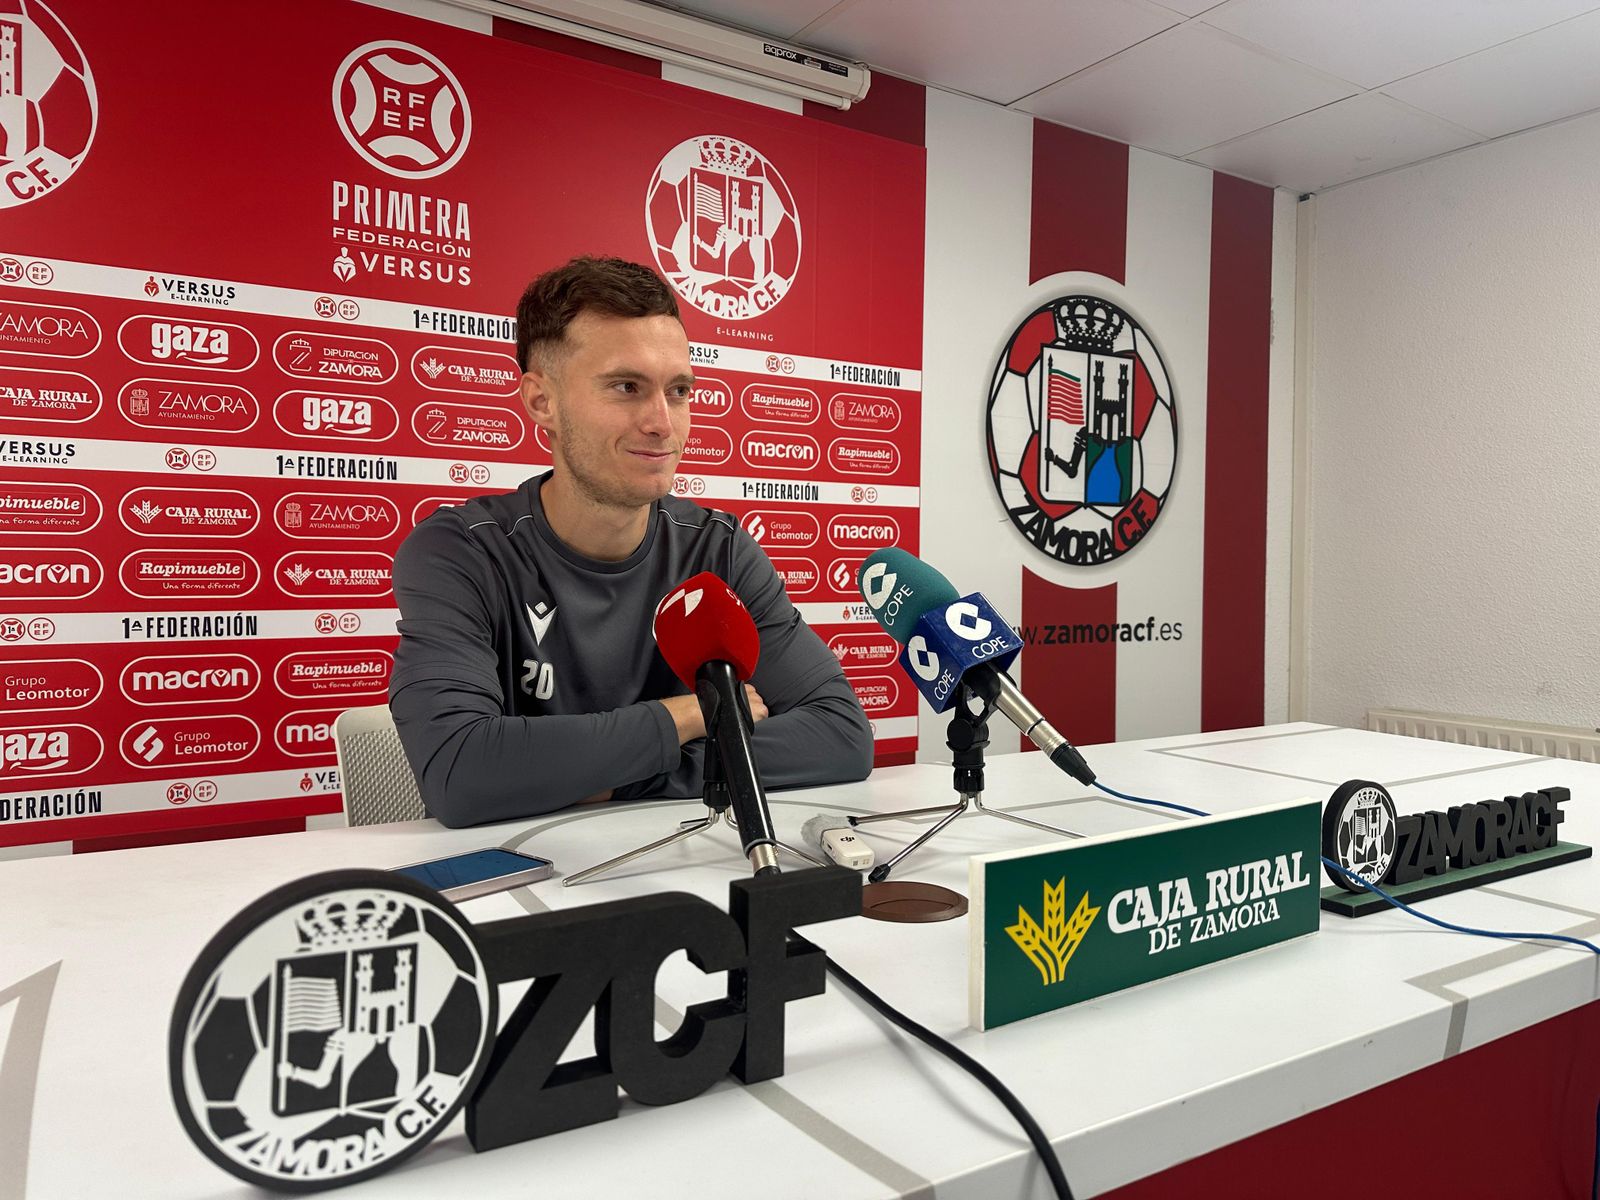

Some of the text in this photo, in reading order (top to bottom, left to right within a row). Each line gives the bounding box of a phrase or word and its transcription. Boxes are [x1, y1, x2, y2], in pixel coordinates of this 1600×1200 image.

[765, 45, 797, 60] aqprox
[333, 181, 470, 241] PRIMERA
[333, 227, 470, 258] FEDERACIÓN
[360, 251, 471, 286] VERSUS
[162, 278, 236, 299] VERSUS
[170, 294, 230, 306] E-LEARNING
[0, 312, 88, 340] AMORA
[152, 322, 229, 358] gaza
[716, 327, 774, 342] E-LEARNING
[688, 346, 720, 360] RSUS
[318, 362, 383, 378] ZAMORA
[448, 364, 518, 381] CAJA RURAL
[842, 364, 901, 387] FEDERACIÓN
[474, 376, 506, 386] ZAMORA
[12, 398, 76, 410] DE ZAMORA
[38, 390, 92, 404] RURAL
[158, 391, 248, 414] ZAMORA
[752, 392, 810, 408] Rapimueble
[158, 412, 216, 422] AYUNTAMIENTO
[303, 397, 372, 431] gaza
[848, 402, 895, 420] ZAMORA
[452, 430, 511, 445] ZAMORA
[686, 437, 702, 446] upo
[748, 441, 814, 461] macron
[838, 446, 891, 460] Rapimueble
[2, 455, 68, 464] E-LEARNING
[298, 456, 398, 480] FEDERACIÓN
[756, 482, 819, 501] FEDERACIÓN
[165, 506, 252, 520] CAJA RURAL
[310, 504, 390, 523] ZAMORA
[13, 517, 40, 526] forma
[42, 518, 80, 526] diferente
[182, 517, 238, 526] DE ZAMORA
[770, 521, 792, 532] Grupo
[1008, 494, 1115, 563] ZAMORA
[770, 530, 814, 541] Leomotor
[833, 524, 894, 540] macron
[139, 562, 241, 578] Rapimueble
[315, 568, 392, 580] CAJA RURAL
[787, 571, 815, 580] RURAL
[182, 582, 206, 590] forma
[208, 581, 241, 590] diferente
[344, 578, 380, 586] ZAMORA
[852, 606, 872, 616] VER
[884, 584, 914, 626] COPE
[146, 612, 258, 638] FEDERACIÓN
[1010, 616, 1182, 645] w.zamoracf.es
[972, 636, 1009, 659] COPE
[292, 662, 382, 678] Rapimueble
[4, 676, 46, 688] Grupo
[132, 668, 249, 691] macron
[520, 658, 554, 700] 20
[934, 669, 955, 700] COPE
[6, 687, 90, 701] Leomotor
[860, 697, 890, 706] AMORA
[174, 731, 211, 744] Grupo
[0, 731, 69, 768] aza
[174, 740, 248, 756] Leomotor
[0, 789, 102, 822] DERACIÓN
[1395, 786, 1571, 886] ZAMORACF
[1107, 851, 1310, 934] CAJA RURAL
[1148, 899, 1280, 956] DE ZAMORA
[465, 865, 863, 1153] ZCF
[222, 1126, 386, 1176] ZAMORA
